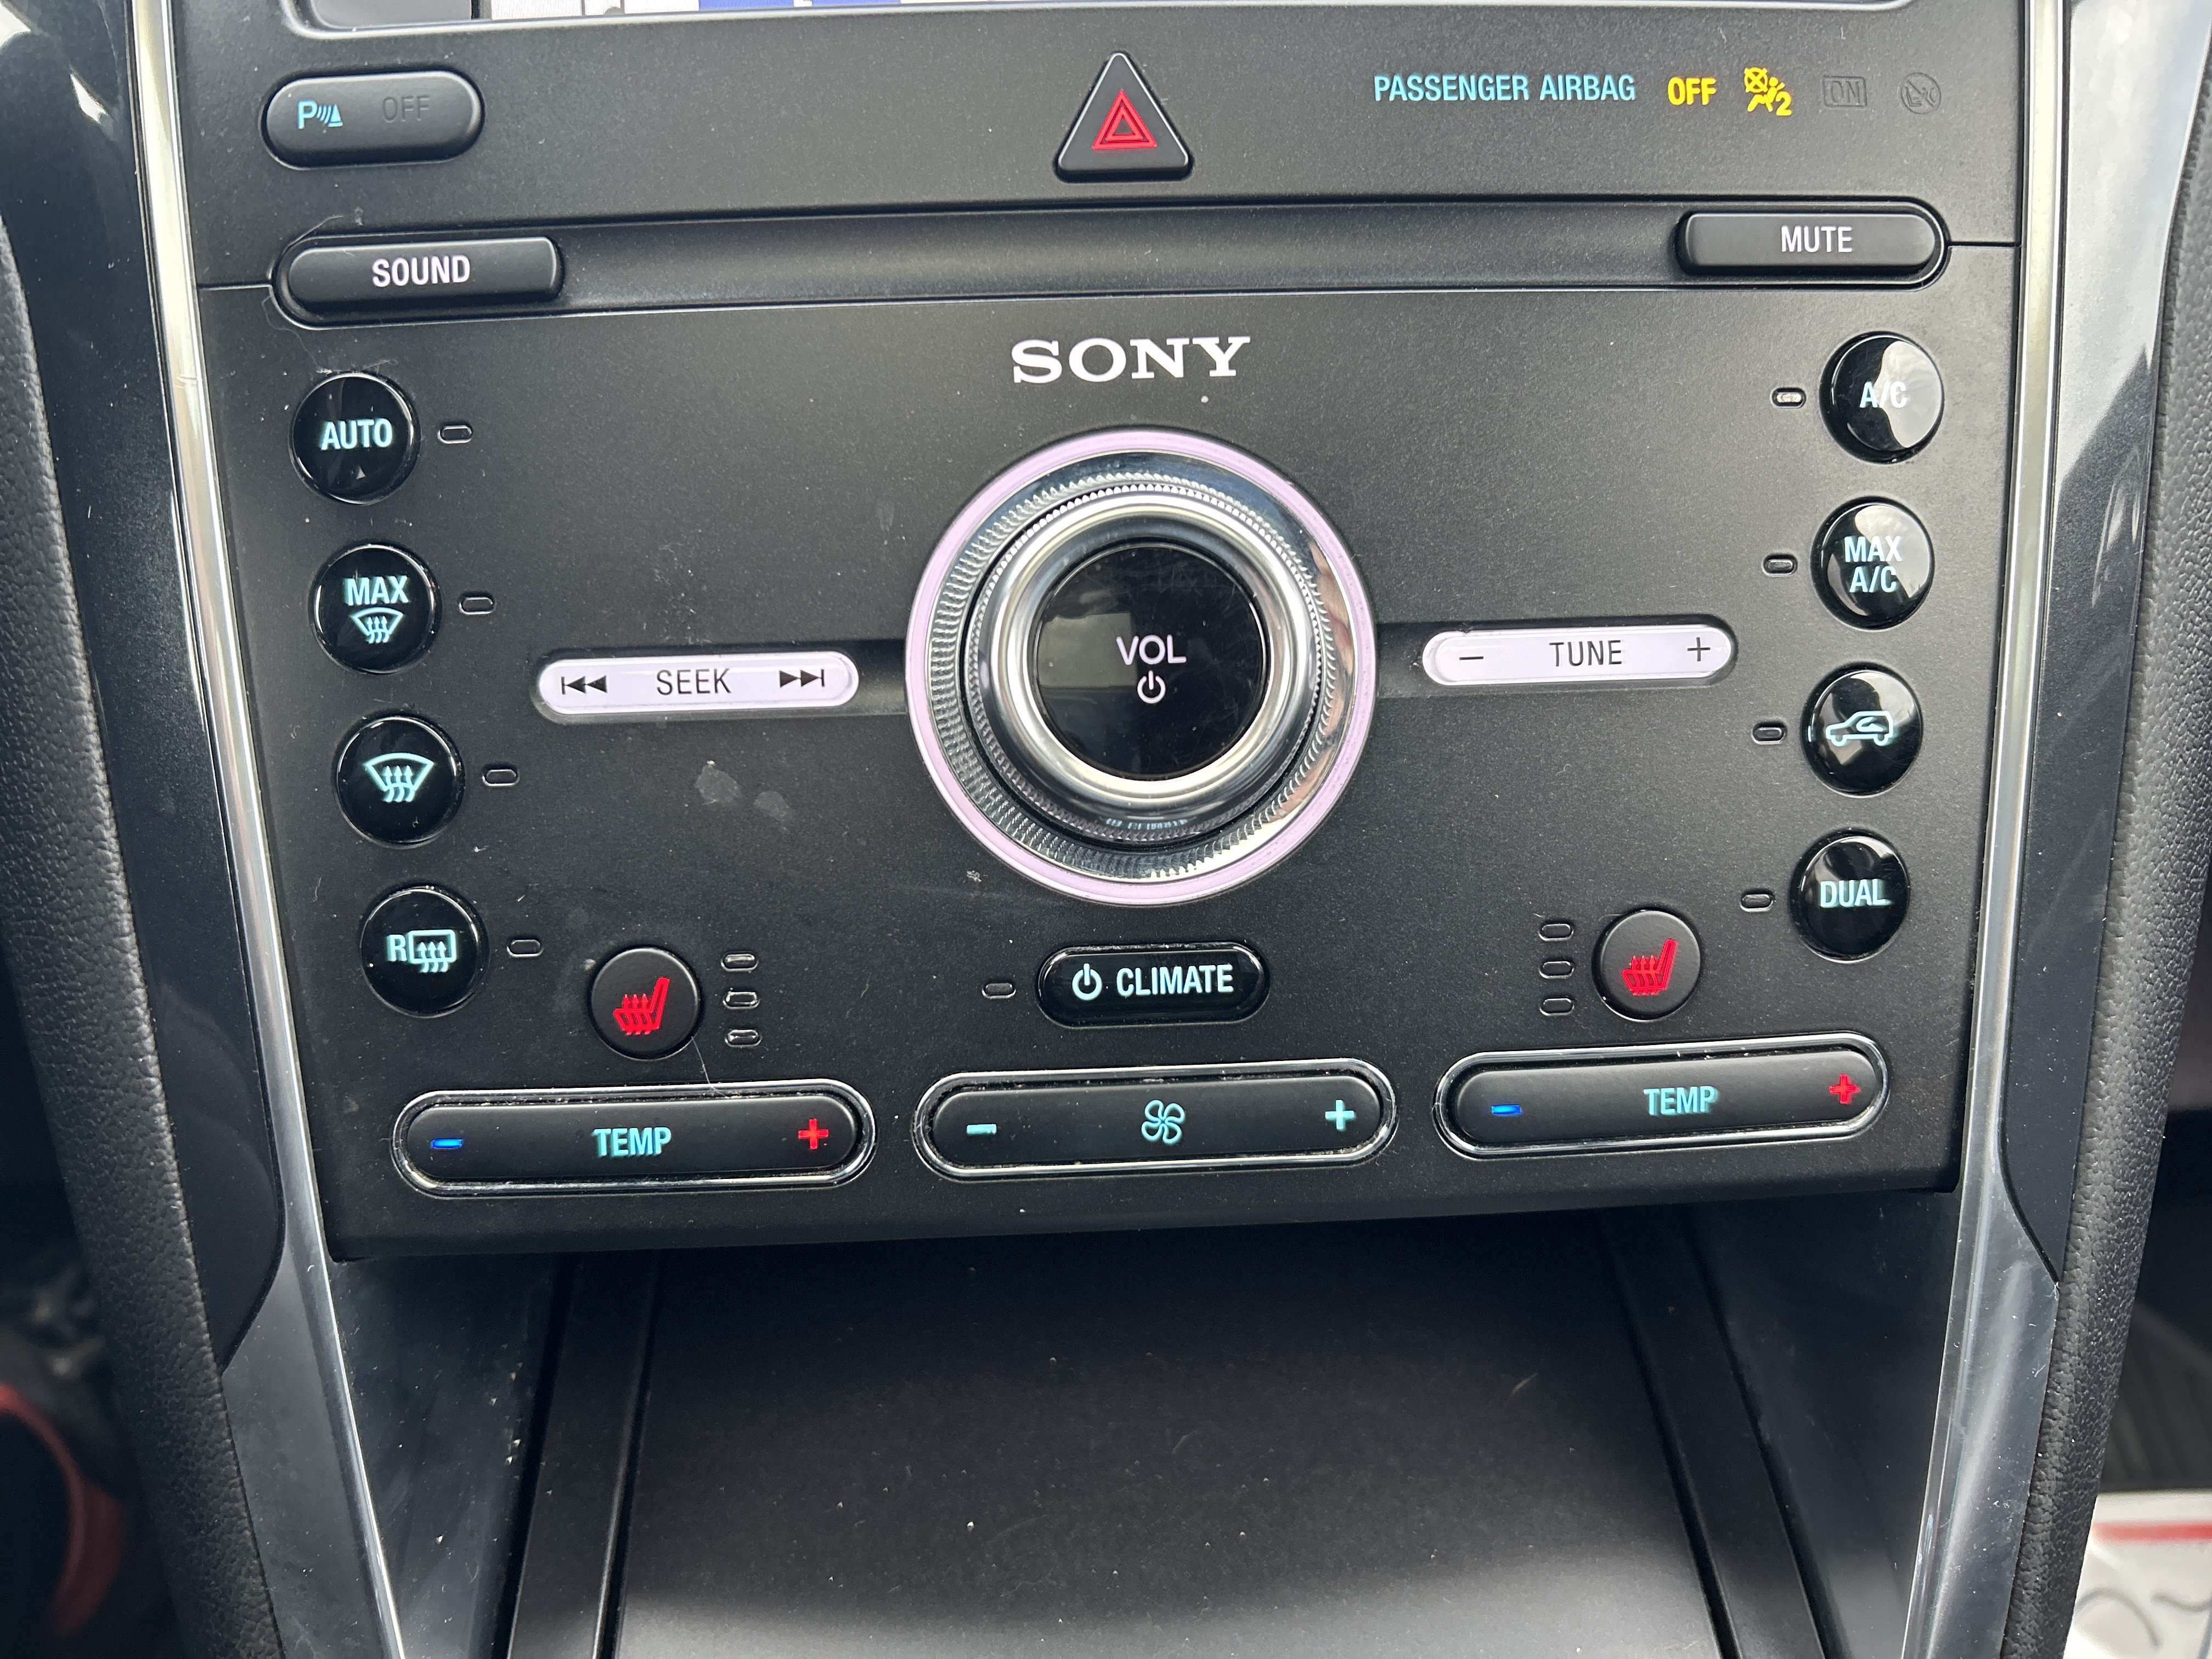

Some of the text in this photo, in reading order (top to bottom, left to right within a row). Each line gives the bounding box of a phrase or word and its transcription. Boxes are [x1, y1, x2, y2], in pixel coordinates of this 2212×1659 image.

[1374, 73, 1717, 105] PASSENGER AIRBAG OFF
[1830, 81, 1861, 105] ON
[382, 95, 430, 123] OFF
[1781, 225, 1854, 253] MUTE
[372, 255, 471, 287] SOUND
[1011, 336, 1251, 383] SONY
[1859, 381, 1908, 408] A/C
[320, 418, 393, 451] AUTO
[1844, 536, 1903, 563] MAX
[344, 575, 409, 606] MAX
[1849, 566, 1898, 592] A/C
[1116, 635, 1187, 665] VOL
[1548, 640, 1623, 667] TUNE
[656, 668, 732, 695] SEEK
[1819, 879, 1892, 908] DUAL
[386, 934, 407, 962] R
[1116, 964, 1234, 997] CLIMATE
[1643, 1086, 1718, 1116] TEMP
[591, 1127, 672, 1157] TEMP
